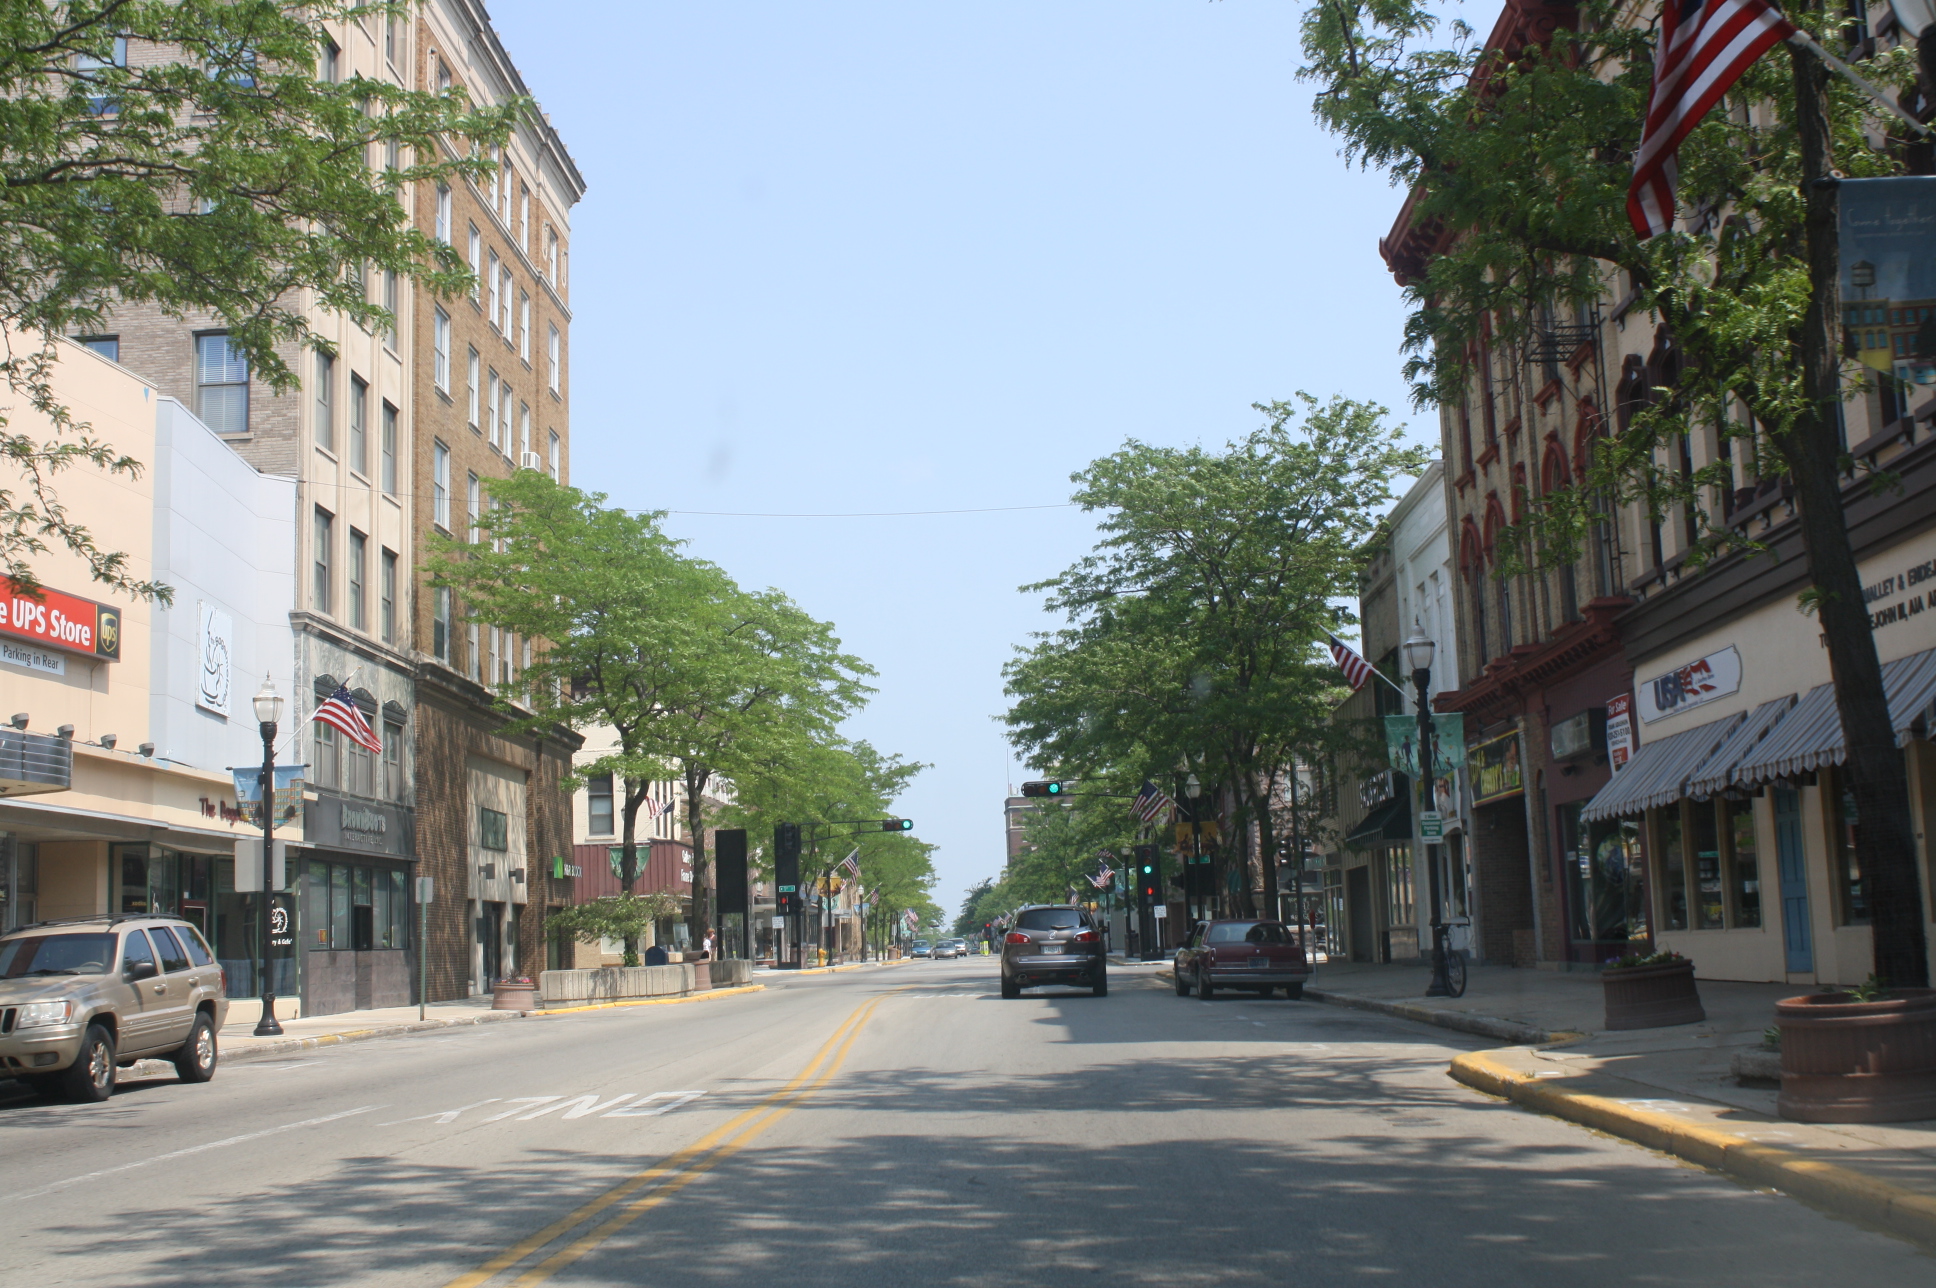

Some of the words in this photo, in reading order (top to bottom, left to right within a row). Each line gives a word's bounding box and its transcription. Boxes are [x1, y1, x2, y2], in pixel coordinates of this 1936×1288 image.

[1898, 574, 1905, 590] &
[1908, 596, 1925, 616] AIA
[13, 598, 46, 634] UPS
[50, 609, 91, 646] Store
[102, 623, 117, 646] ups
[3, 644, 31, 666] Parking
[33, 652, 41, 665] in
[42, 656, 59, 670] Rear
[1616, 700, 1627, 713] Sale
[199, 798, 216, 819] The
[378, 1090, 708, 1125] ONLY
